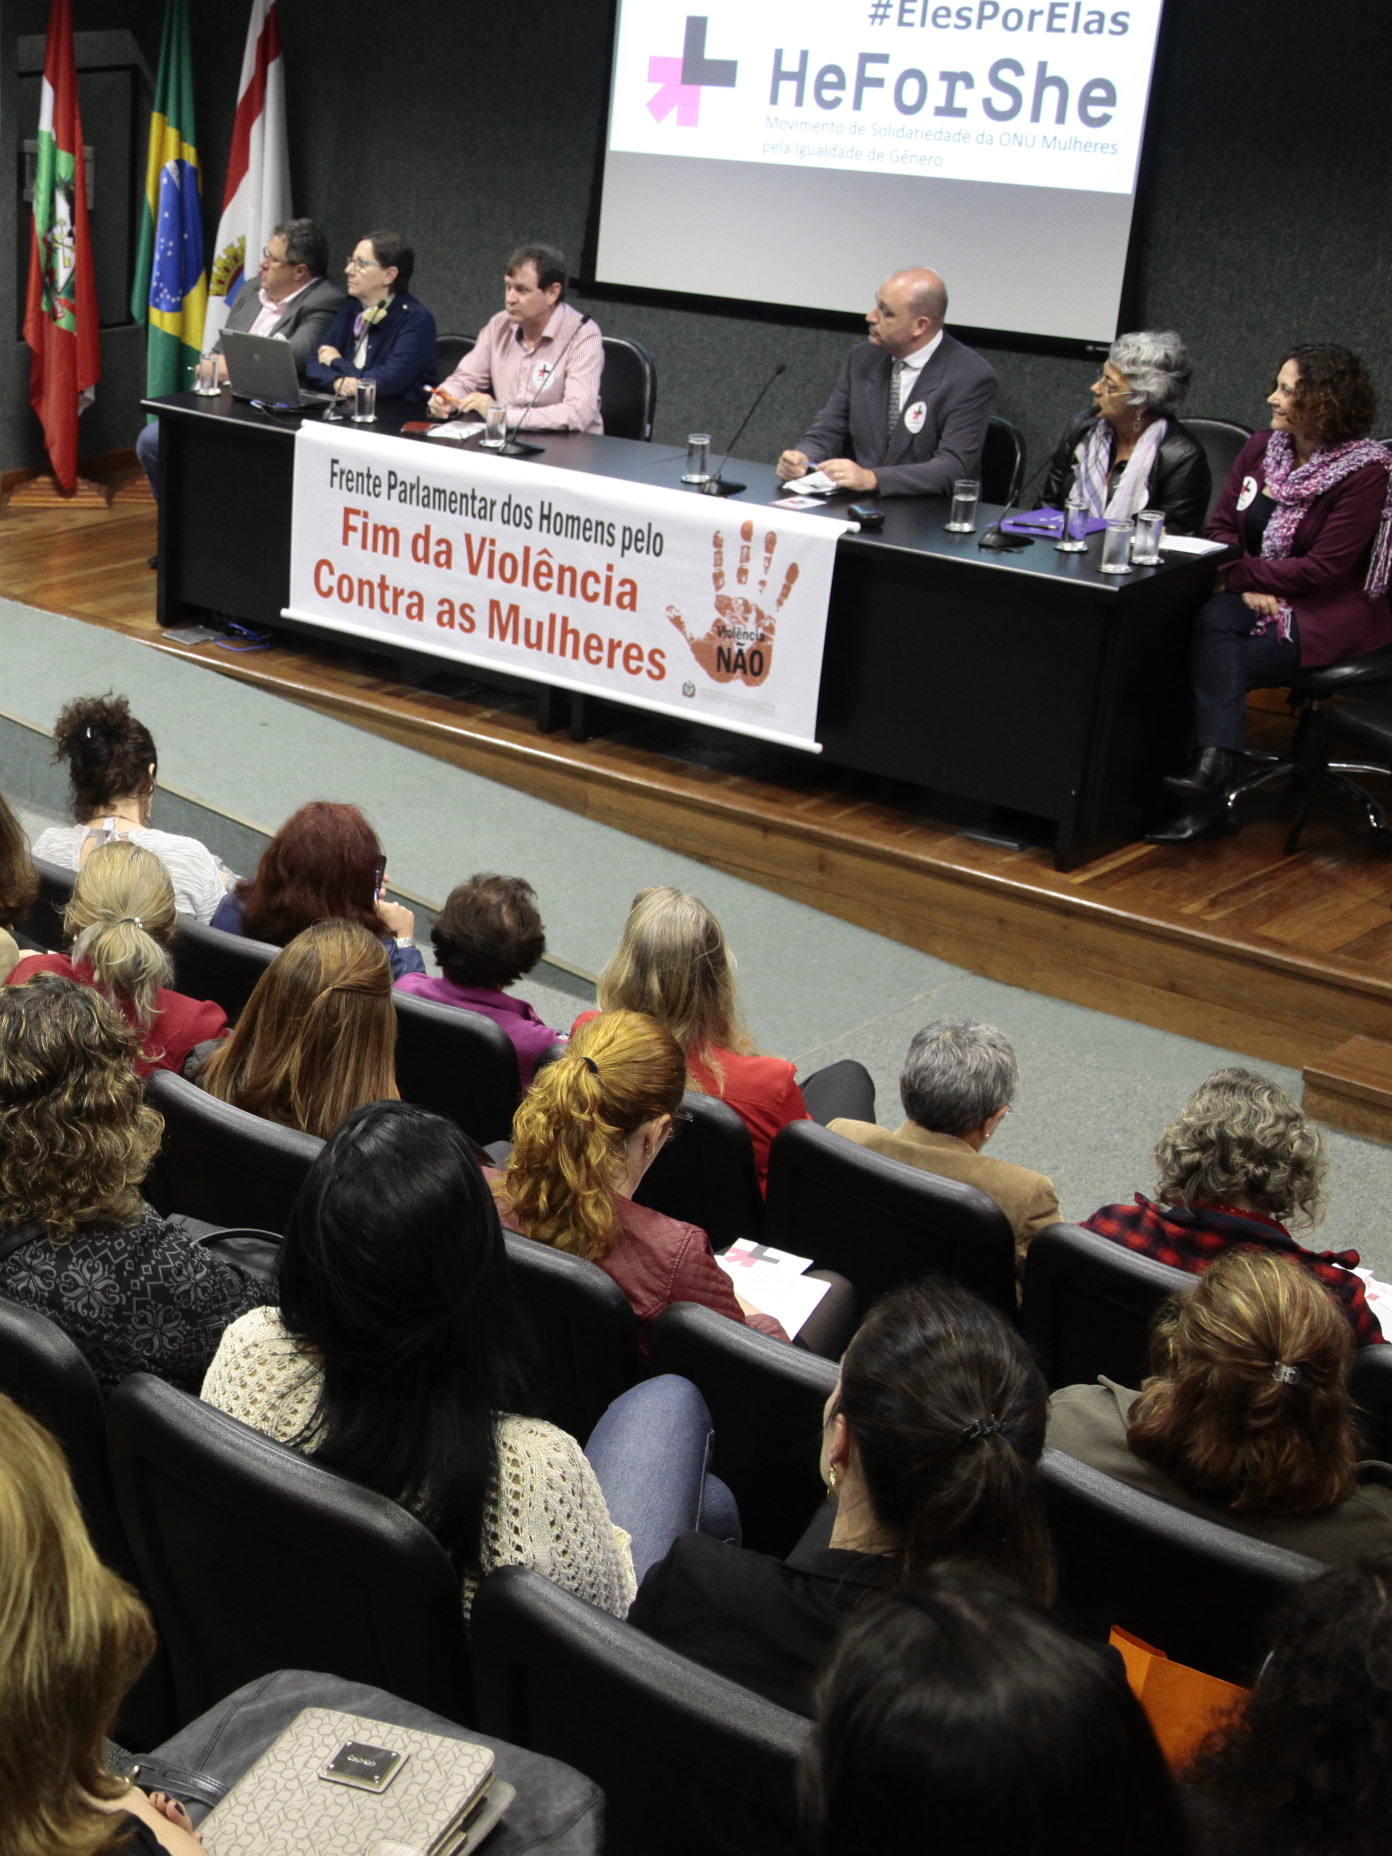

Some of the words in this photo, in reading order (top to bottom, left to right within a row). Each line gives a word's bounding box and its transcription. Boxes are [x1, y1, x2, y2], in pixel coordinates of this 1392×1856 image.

[867, 0, 1131, 36] #ElesPorElas
[768, 48, 1118, 128] HeForShe
[762, 140, 791, 155] pela
[795, 143, 863, 160] Igualdade
[867, 146, 885, 162] de
[765, 116, 845, 134] Movimento
[848, 122, 866, 136] de
[870, 123, 971, 144] Solidariedade
[975, 130, 994, 146] da
[999, 132, 1036, 149] ONU
[1041, 135, 1118, 155] Mulheres
[329, 457, 383, 499] Frente
[387, 470, 497, 526] Parlamentar
[501, 495, 534, 530] dos
[539, 500, 617, 547] Homens
[621, 522, 665, 558] pelo
[341, 506, 401, 558] Fim
[411, 522, 454, 570] da
[464, 532, 639, 613] Violência
[313, 558, 425, 622] Contra
[436, 596, 477, 634] as
[488, 599, 667, 681] Mulheres
[717, 625, 766, 642] Violência
[716, 641, 764, 677] NÃO
